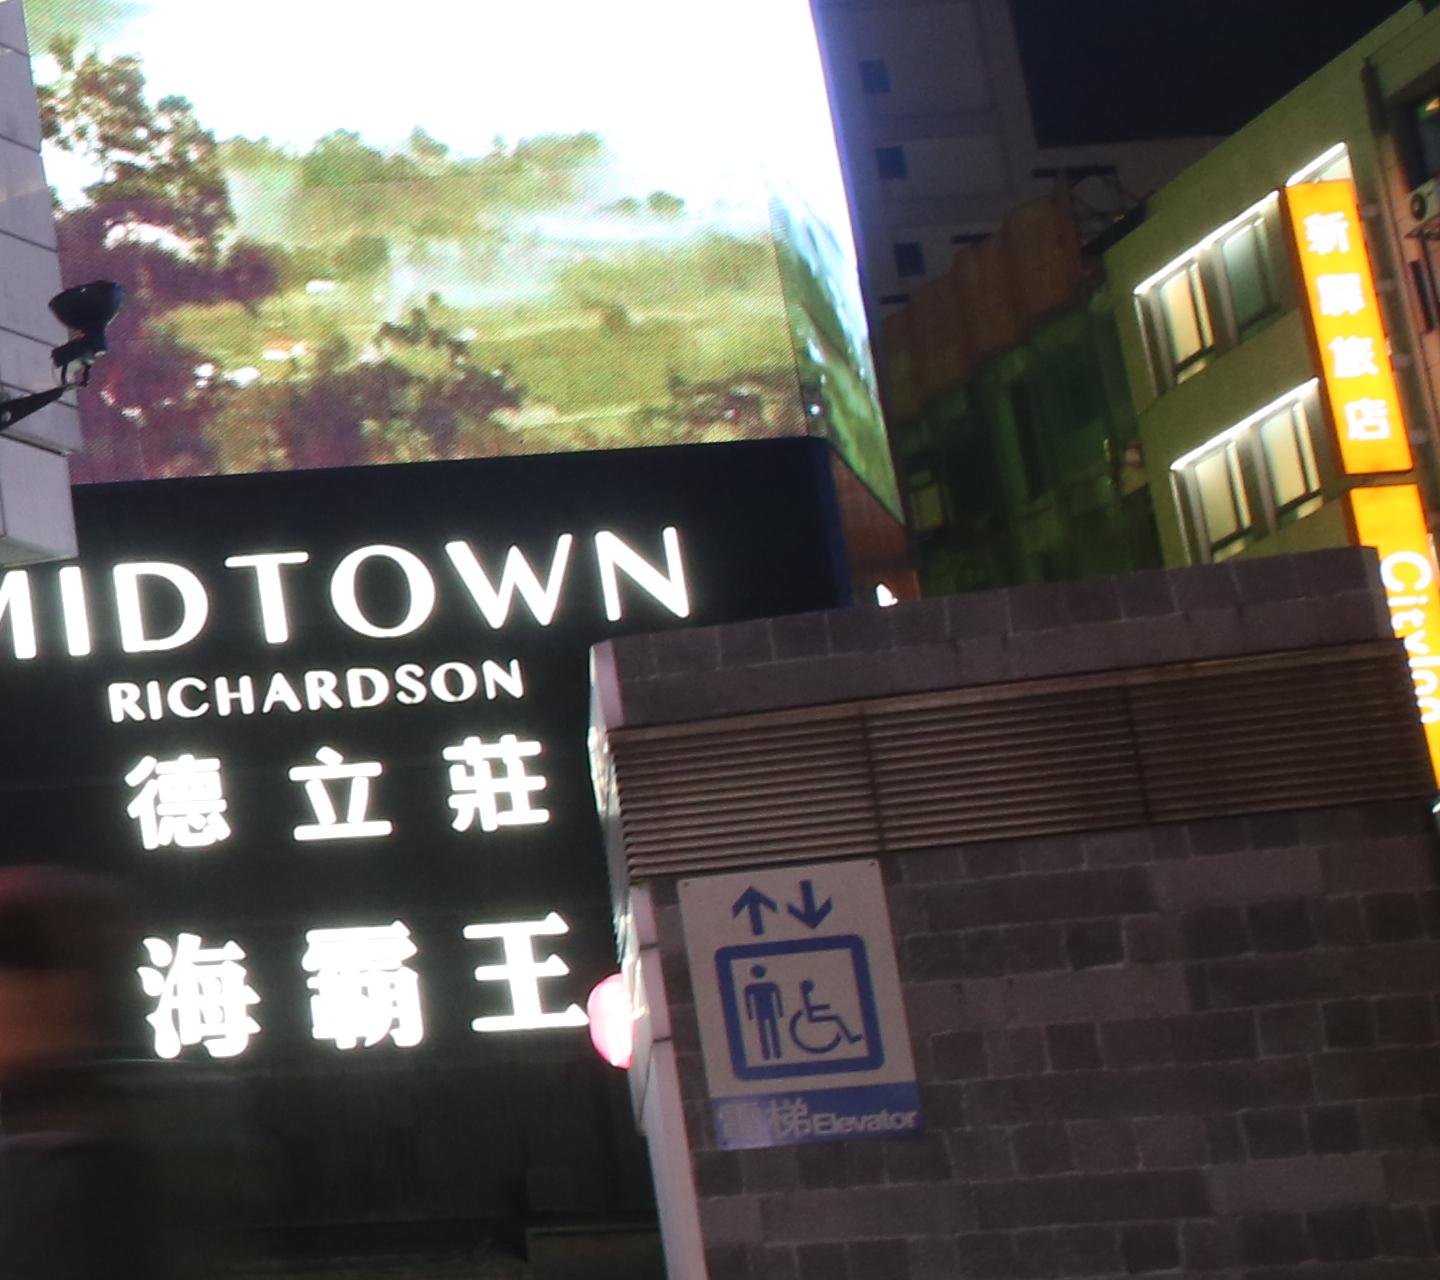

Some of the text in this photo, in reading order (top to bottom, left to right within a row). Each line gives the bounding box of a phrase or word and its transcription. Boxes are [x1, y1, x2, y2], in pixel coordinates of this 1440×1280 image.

[108, 659, 524, 723] RICHARDSON
[125, 733, 549, 851] 德立莊
[136, 910, 589, 1061] 海霸王
[812, 1108, 918, 1136] Elevator
